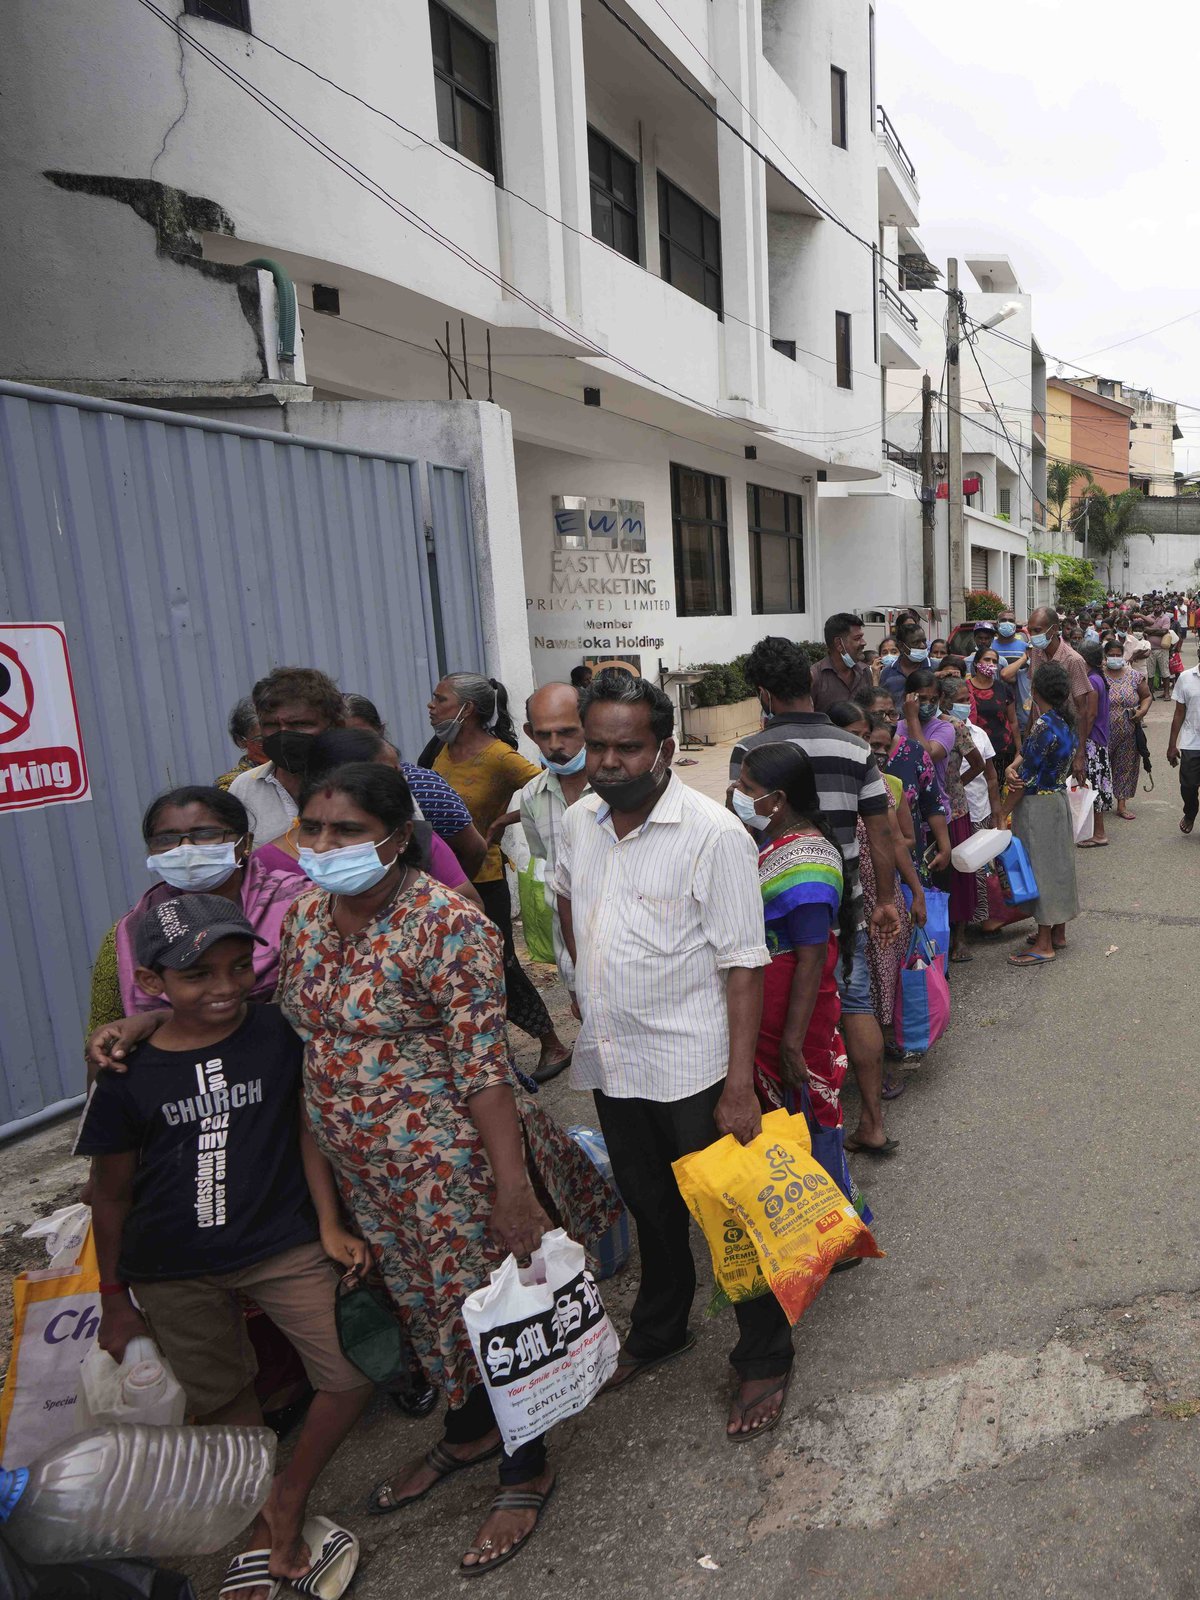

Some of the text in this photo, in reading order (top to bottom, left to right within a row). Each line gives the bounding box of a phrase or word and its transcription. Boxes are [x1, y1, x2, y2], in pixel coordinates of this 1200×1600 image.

[551, 551, 652, 575] EAST WEST
[550, 573, 656, 595] MARKETING
[625, 600, 670, 611] LIMITED
[584, 620, 633, 630] Member
[616, 635, 665, 650] Holdings
[0, 760, 72, 794] rking
[195, 1063, 207, 1095] I
[205, 1058, 228, 1092] go to
[161, 1078, 263, 1126] CHURCH
[200, 1112, 230, 1132] coz
[198, 1130, 229, 1151] my
[194, 1151, 214, 1228] confessions
[213, 1149, 226, 1226] never end
[773, 1213, 804, 1237] PREMIUM
[819, 1212, 840, 1228] 5kg
[723, 1250, 757, 1264] PREMIU
[44, 1305, 100, 1345] Ch
[507, 1386, 527, 1398] Your
[528, 1371, 550, 1389] Smile
[552, 1367, 559, 1375] is
[561, 1360, 572, 1370] Ou
[584, 1323, 608, 1347] Returns
[43, 1394, 78, 1411] Special
[527, 1386, 567, 1416] GENTLE
